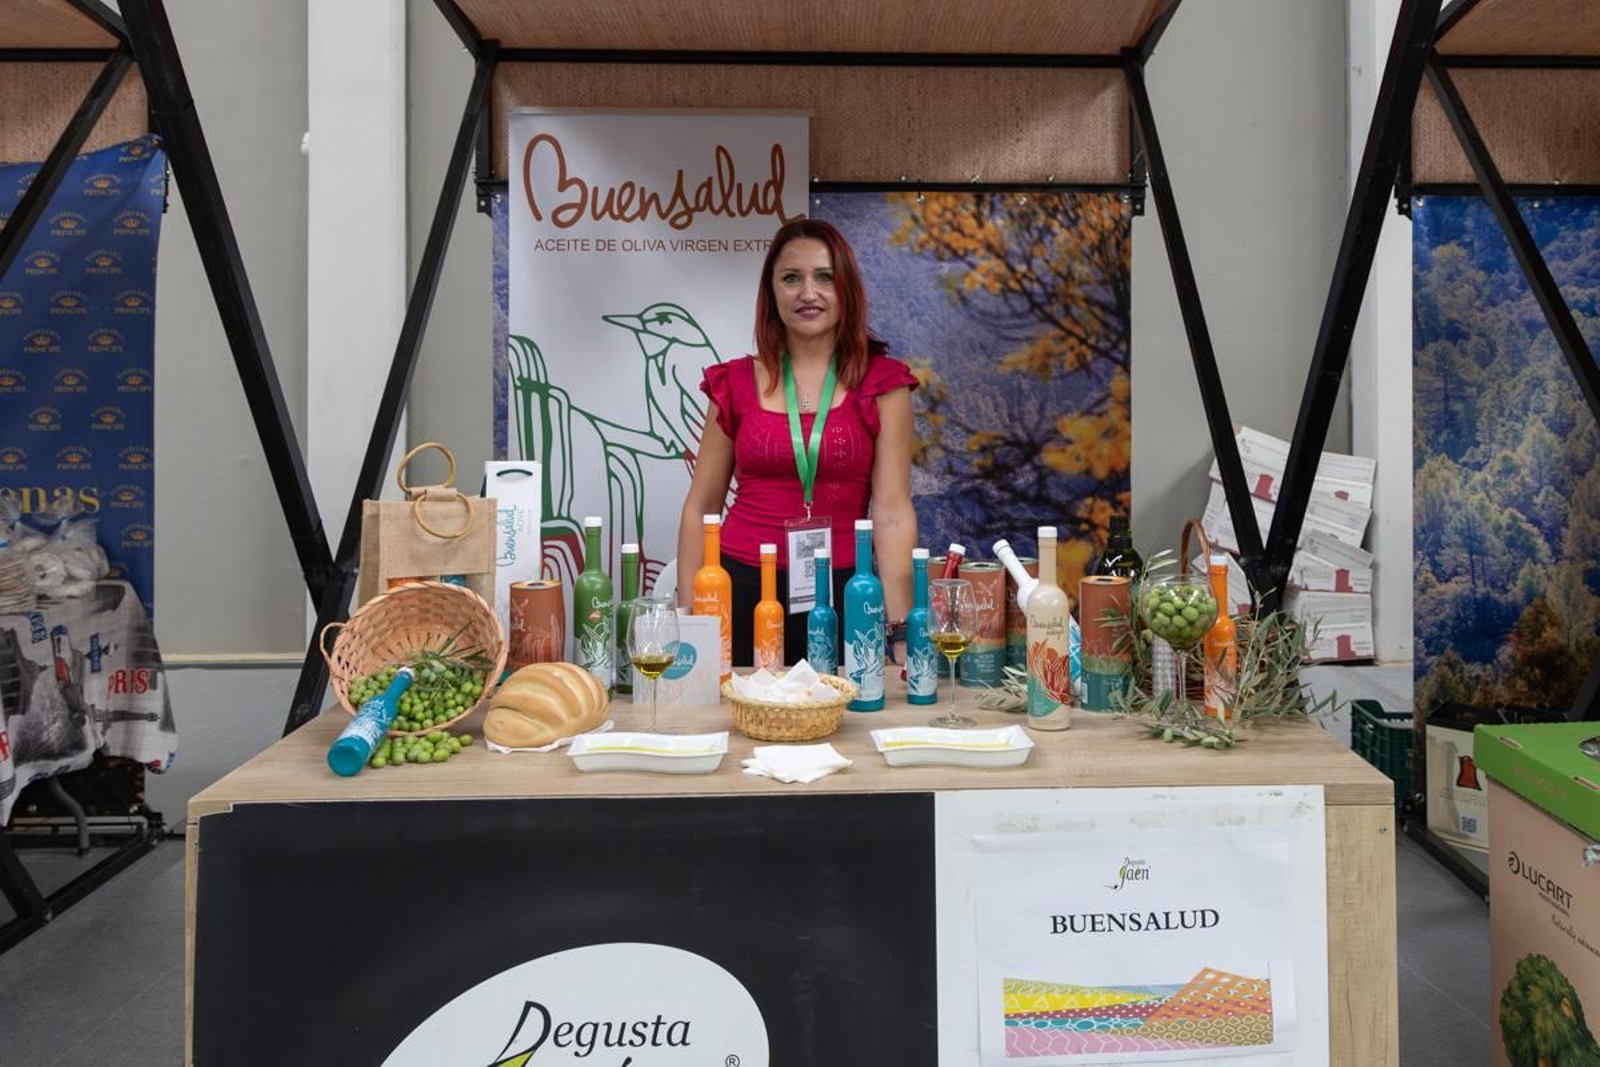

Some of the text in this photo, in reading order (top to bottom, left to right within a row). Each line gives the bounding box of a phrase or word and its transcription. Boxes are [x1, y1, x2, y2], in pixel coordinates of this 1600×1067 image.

[523, 133, 807, 230] Buensalud
[534, 238, 771, 252] ACEITE DE OLIVA VIRGEN EXTR
[1521, 861, 1574, 910] LUCART
[1049, 908, 1220, 935] BUENSALUD
[496, 1001, 692, 1057] Degusta
